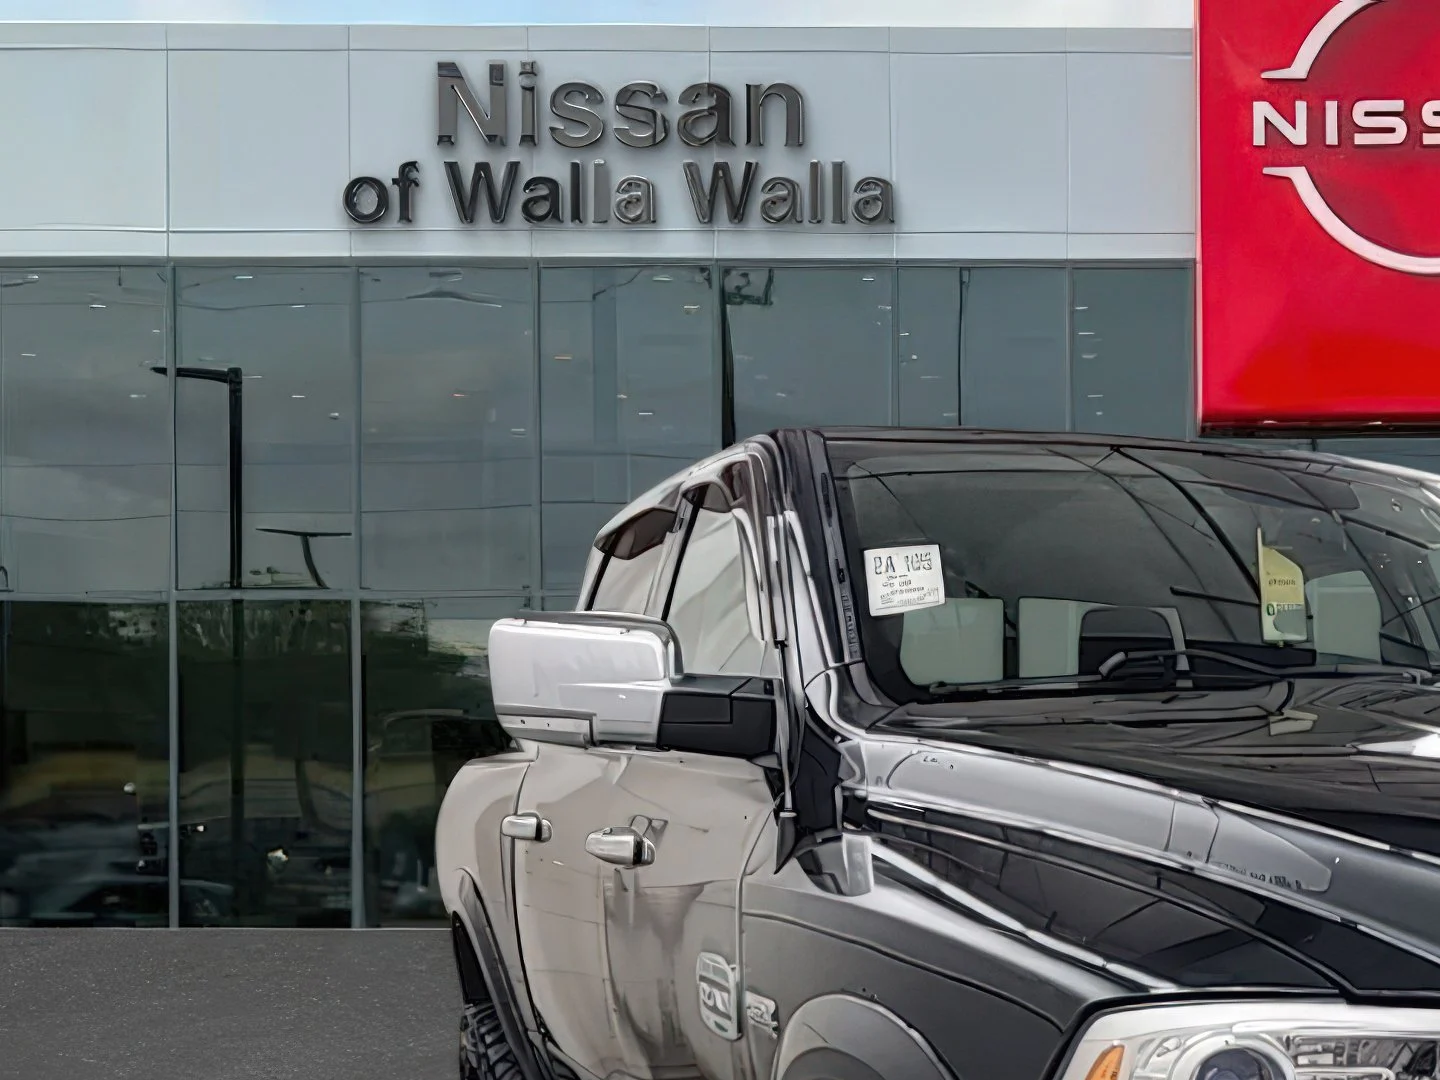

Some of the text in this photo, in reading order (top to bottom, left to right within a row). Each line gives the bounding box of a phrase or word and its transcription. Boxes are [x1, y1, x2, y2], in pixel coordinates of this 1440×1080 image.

[436, 60, 806, 147] Nissan
[343, 160, 895, 224] of Walla Walla
